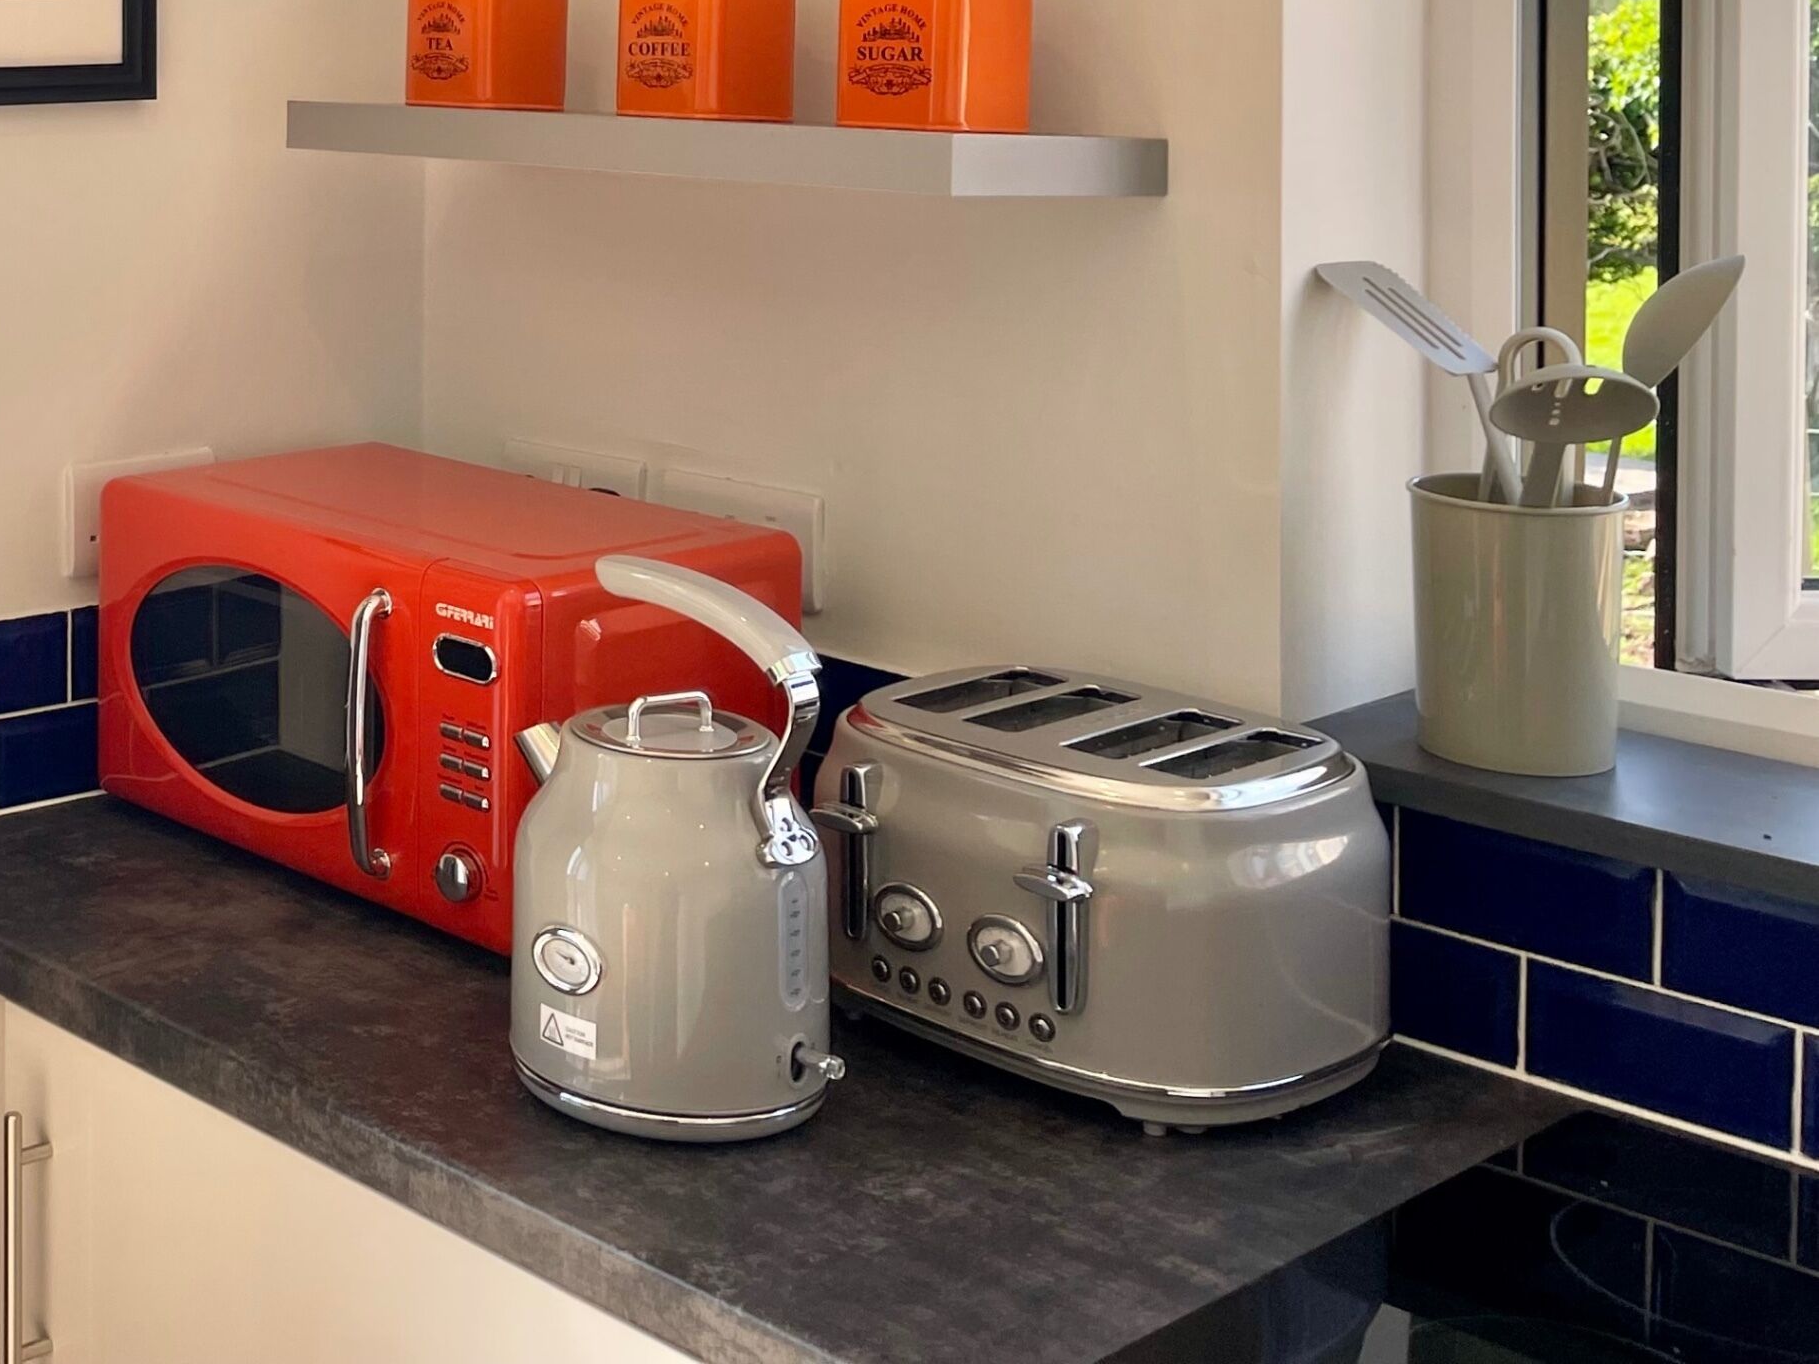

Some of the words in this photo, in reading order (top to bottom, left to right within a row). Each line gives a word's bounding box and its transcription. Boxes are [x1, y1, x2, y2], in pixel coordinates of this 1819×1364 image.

[856, 4, 898, 28] VINTAGE
[900, 5, 927, 31] HOME
[426, 37, 453, 51] TEA
[628, 42, 691, 56] COFFEE
[857, 45, 924, 61] SUGAR
